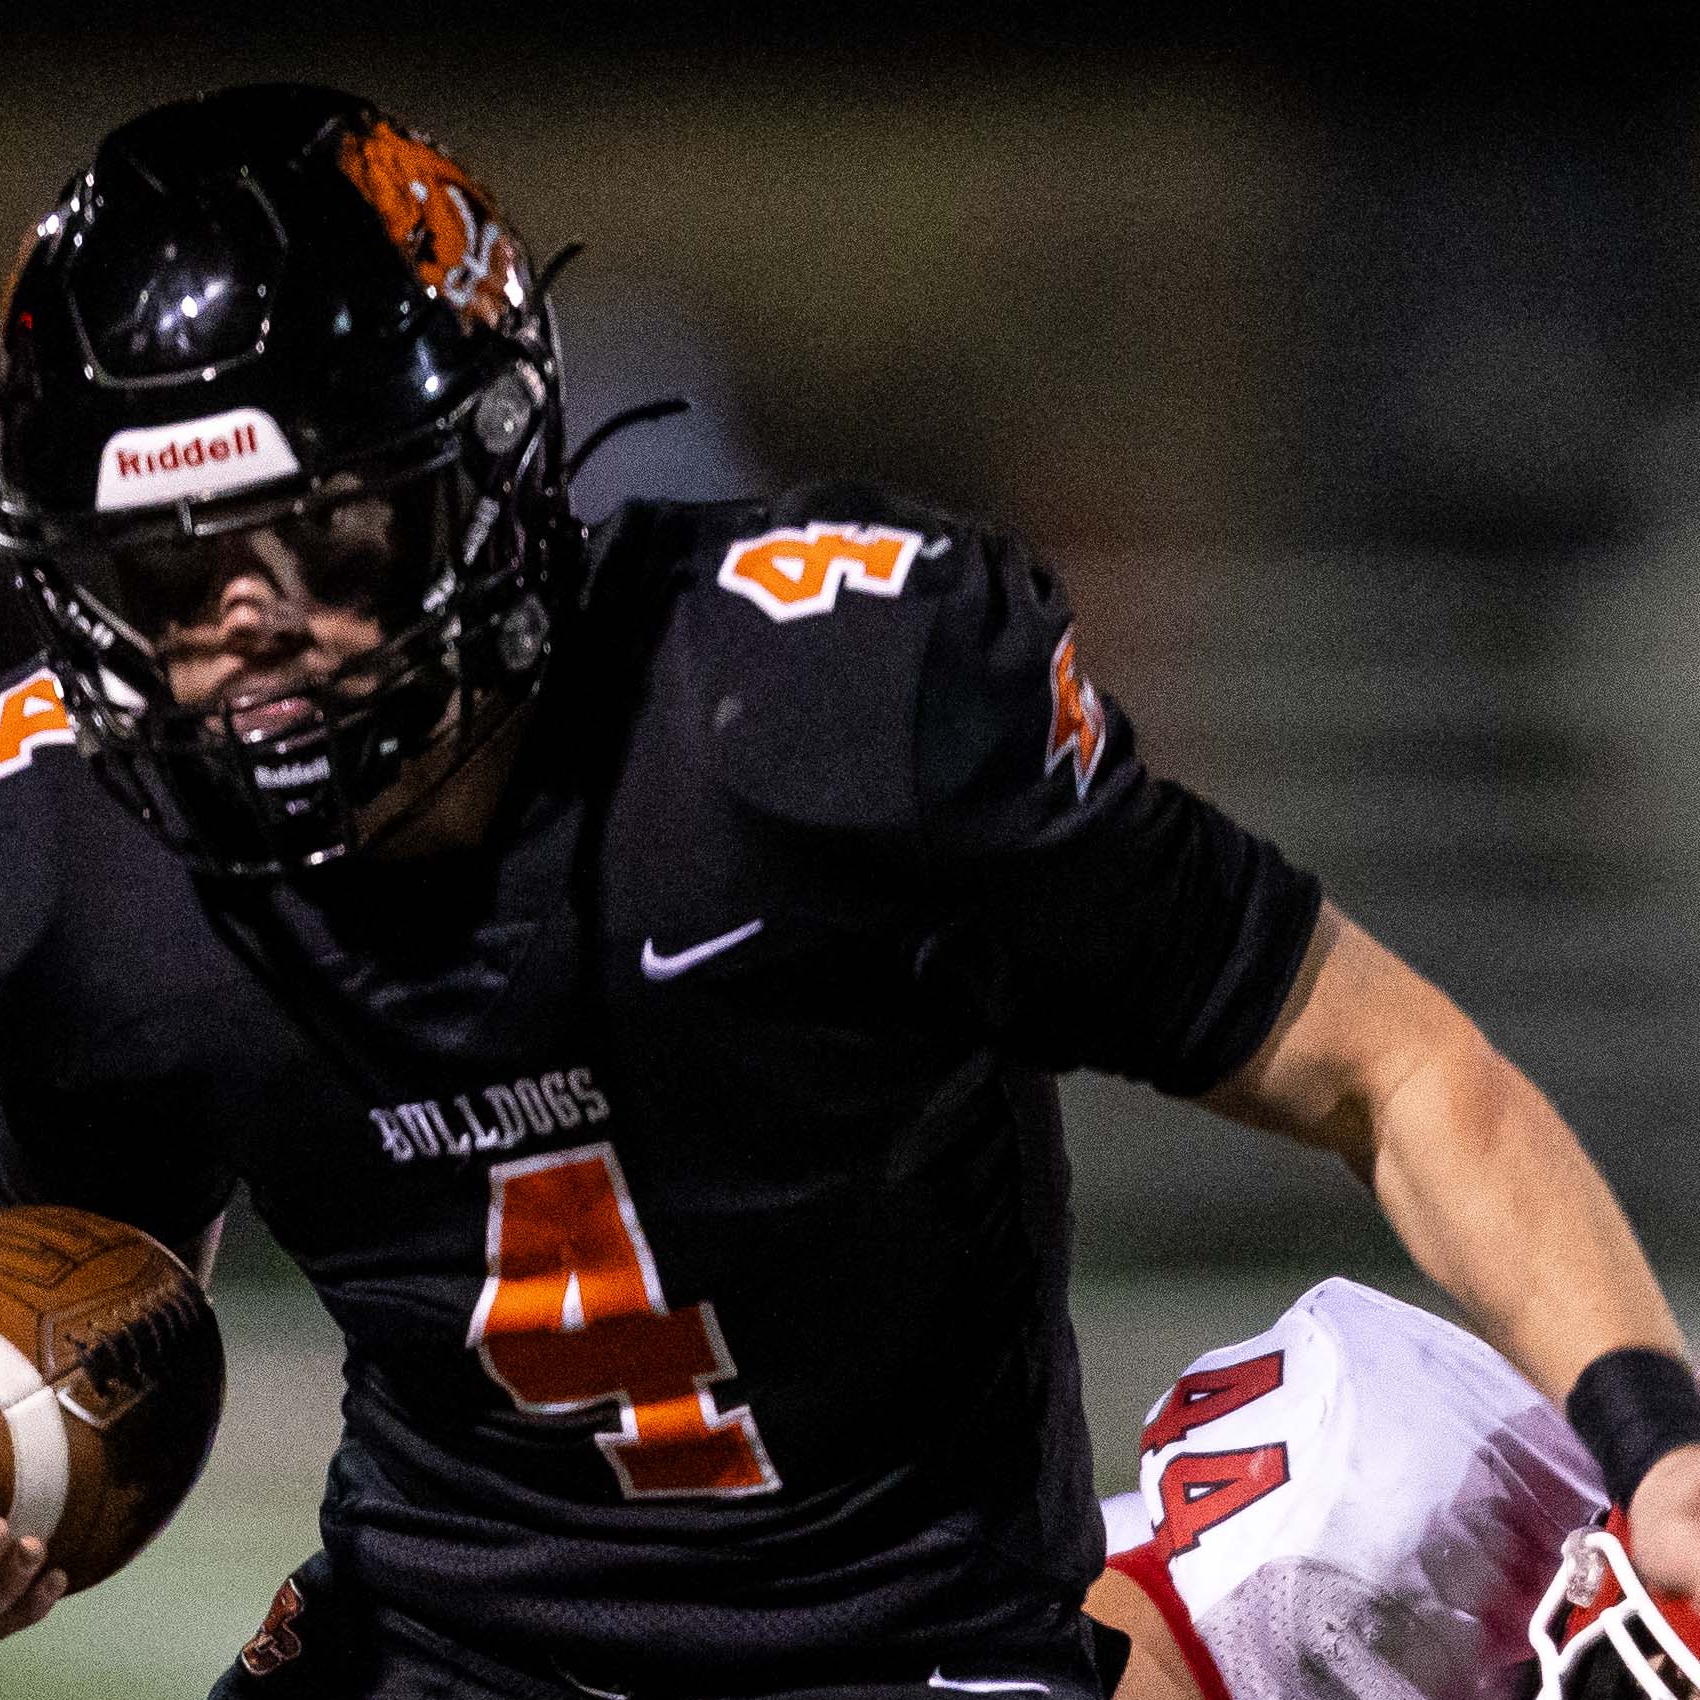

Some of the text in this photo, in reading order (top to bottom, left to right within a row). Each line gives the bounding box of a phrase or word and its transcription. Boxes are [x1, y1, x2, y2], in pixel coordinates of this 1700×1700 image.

[116, 422, 258, 478] Riddell
[718, 520, 923, 622] 4
[368, 1066, 610, 1162] BULLDOGS
[465, 1140, 783, 1501] 4
[1139, 1348, 1291, 1562] 44
